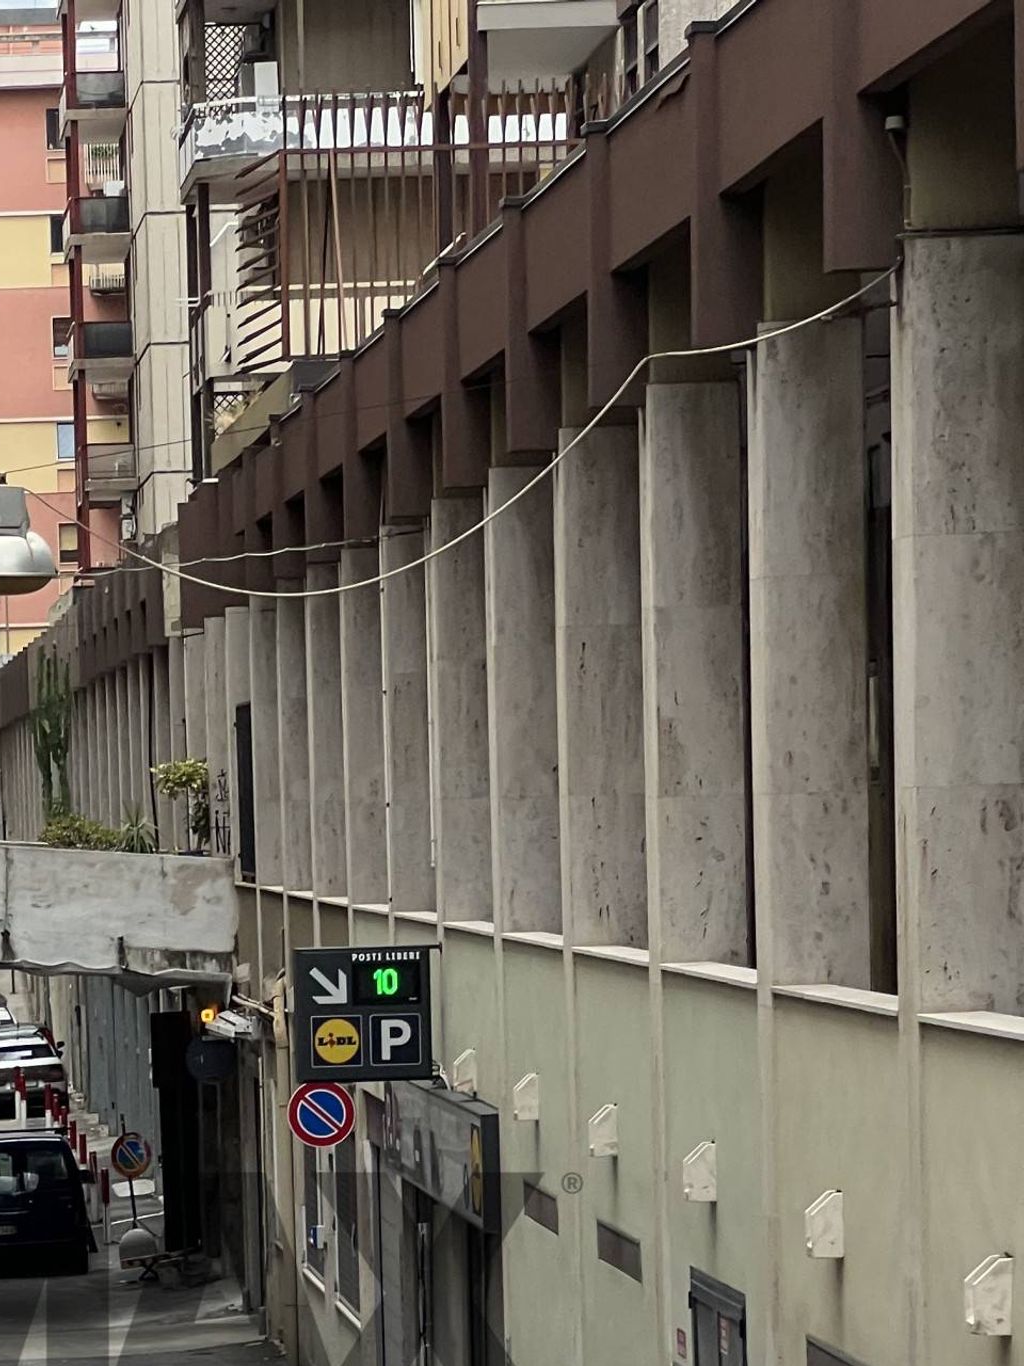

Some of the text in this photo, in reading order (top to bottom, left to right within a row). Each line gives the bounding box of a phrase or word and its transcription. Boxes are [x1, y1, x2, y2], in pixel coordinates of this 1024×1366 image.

[352, 951, 420, 962] POSTI LIBERI
[374, 968, 398, 996] 10
[380, 1019, 412, 1061] P
